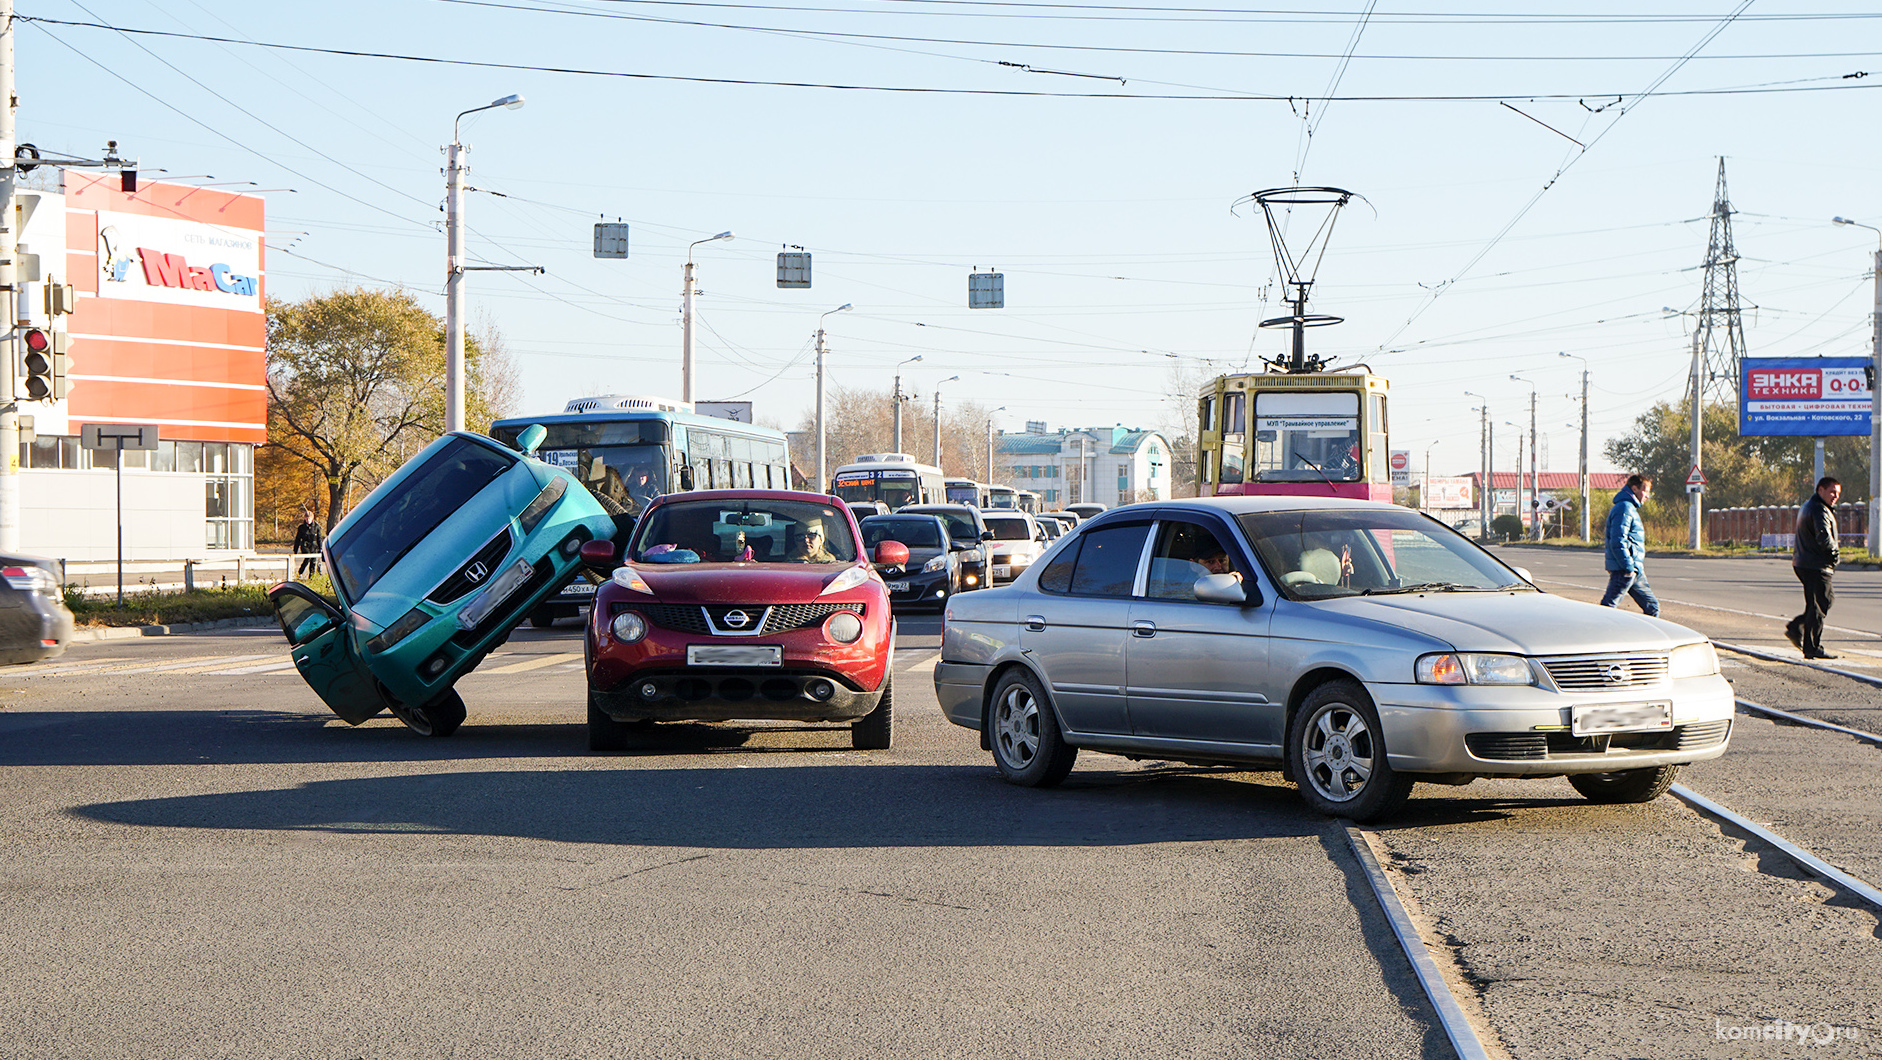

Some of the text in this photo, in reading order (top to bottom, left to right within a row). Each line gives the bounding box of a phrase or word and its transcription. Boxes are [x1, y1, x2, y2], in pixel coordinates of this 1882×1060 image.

[184, 233, 253, 250] СЕТЬ МАГАЗИНОВ
[136, 247, 258, 296] MaCar
[1753, 373, 1818, 387] ЭНКА
[1753, 387, 1818, 395] ТЕХНИКА
[1811, 414, 1853, 422] Котовского,
[546, 451, 559, 466] 19
